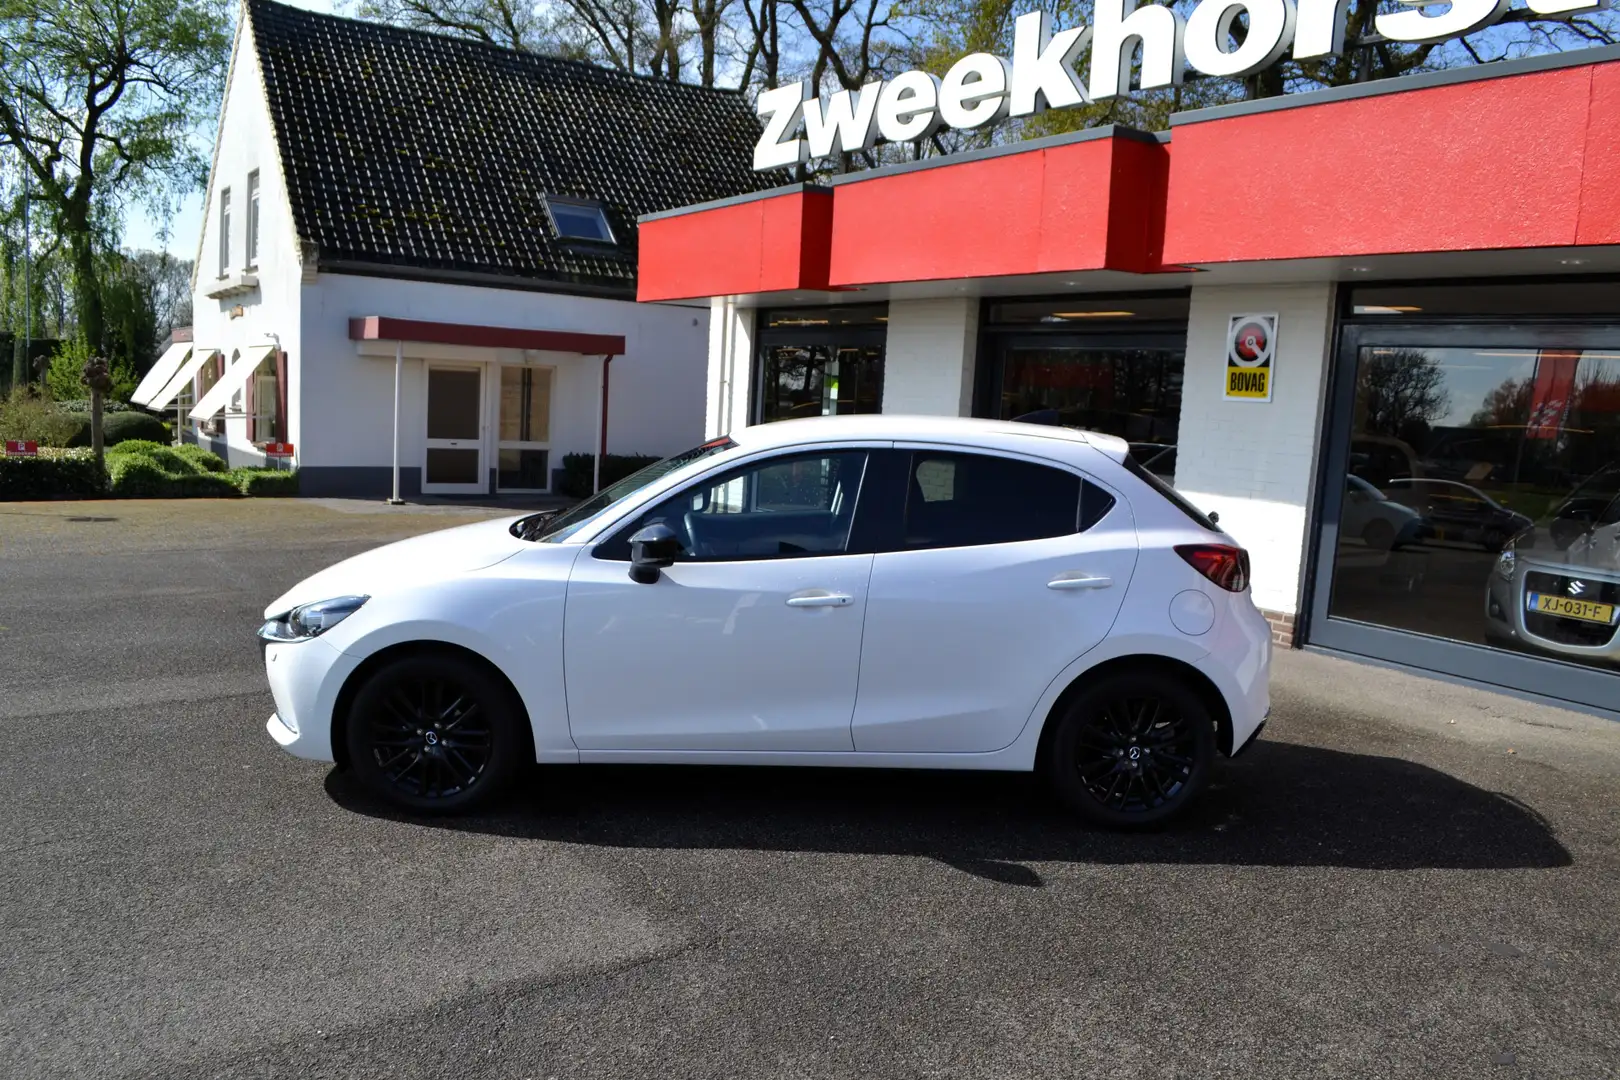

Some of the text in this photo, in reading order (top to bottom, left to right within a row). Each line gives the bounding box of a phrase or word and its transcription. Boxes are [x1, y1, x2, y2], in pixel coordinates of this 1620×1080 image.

[753, 0, 1600, 171] Zweekho
[1230, 372, 1265, 392] BOVAG
[1543, 597, 1602, 618] XJ-031-F
